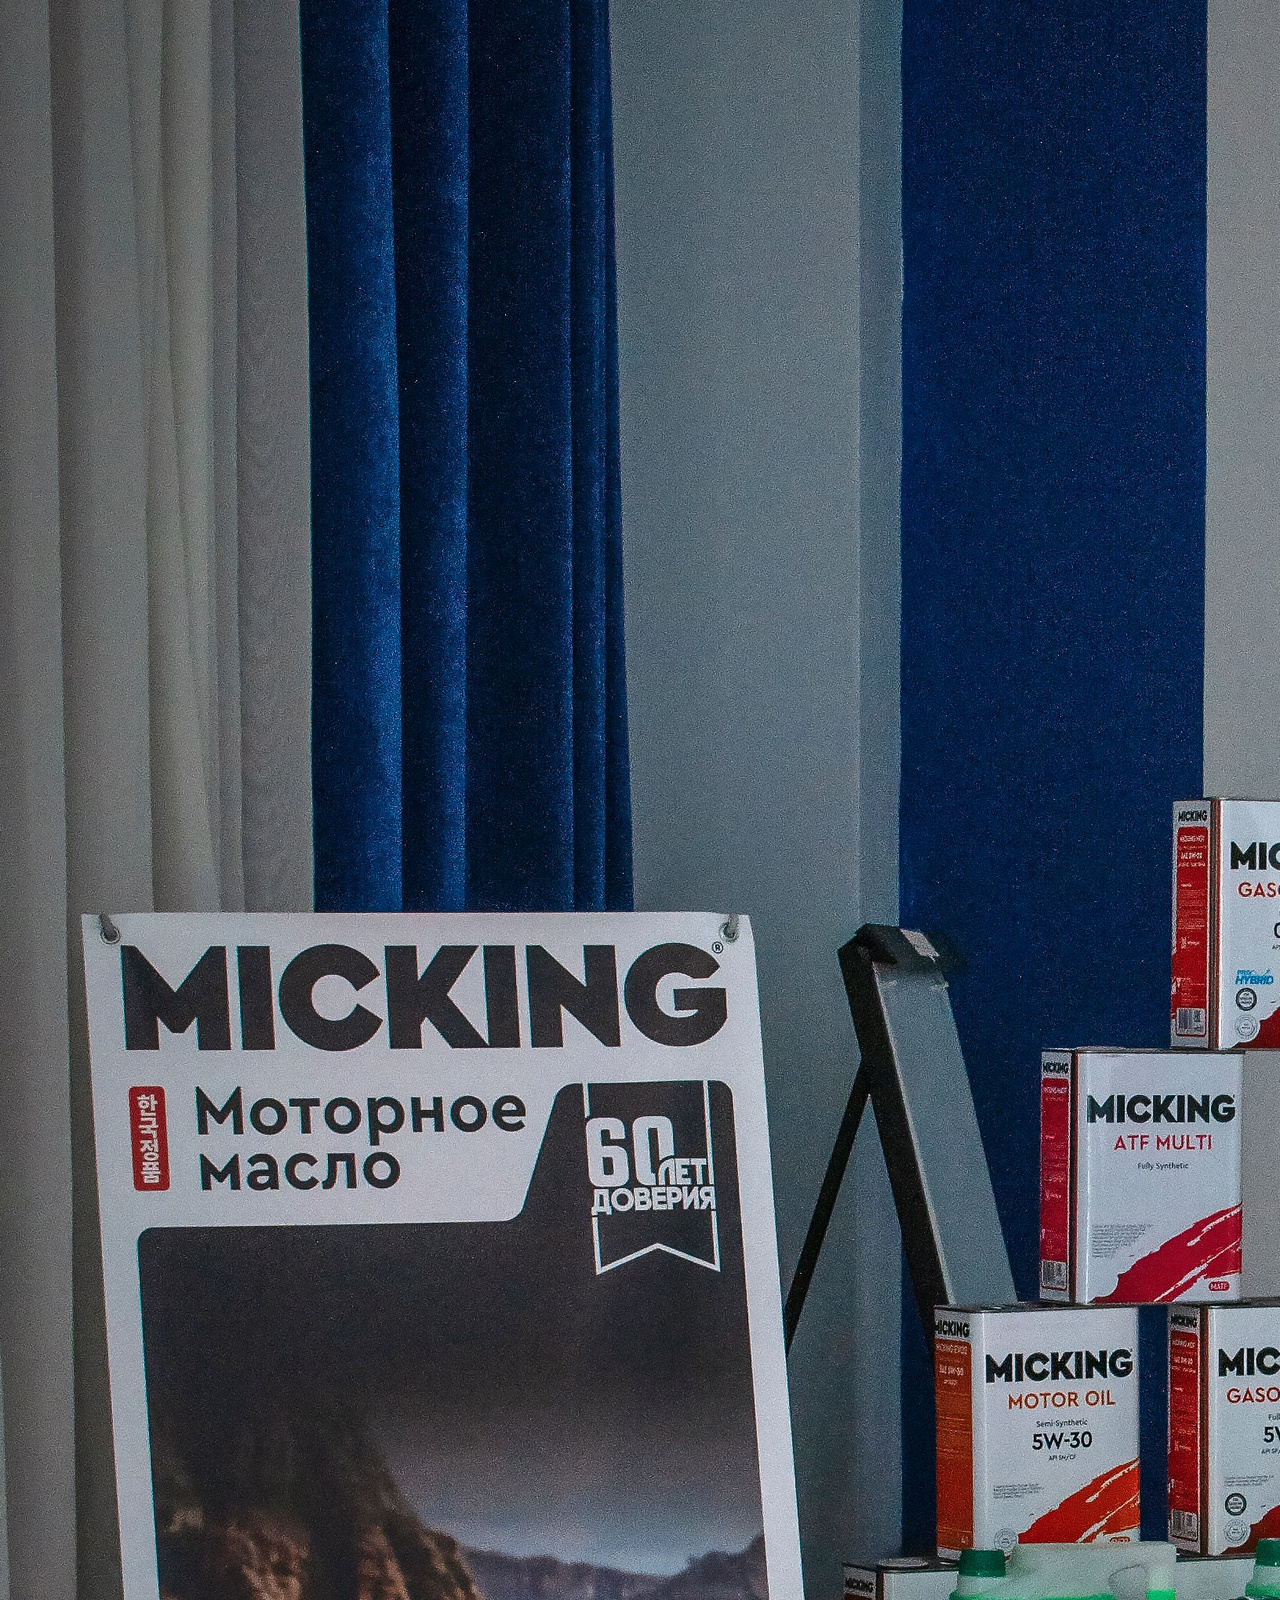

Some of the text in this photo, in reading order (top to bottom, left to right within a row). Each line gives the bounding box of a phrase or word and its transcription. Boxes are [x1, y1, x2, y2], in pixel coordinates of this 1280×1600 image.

[195, 1086, 527, 1145] Моторное
[1087, 1094, 1236, 1124] MICKING
[585, 1115, 707, 1187] 60 ЛЕТ
[1114, 1134, 1212, 1151] ATF MULTI
[199, 1149, 401, 1191] масло
[1137, 1161, 1189, 1170] Fully Synthetic
[591, 1186, 715, 1215] ДОВЕРИЯ
[986, 1349, 1133, 1383] MICKING
[1008, 1390, 1115, 1410] MOTOR OIL
[1036, 1419, 1088, 1428] Semi-Synthetic
[1032, 1432, 1093, 1450] 5W-30
